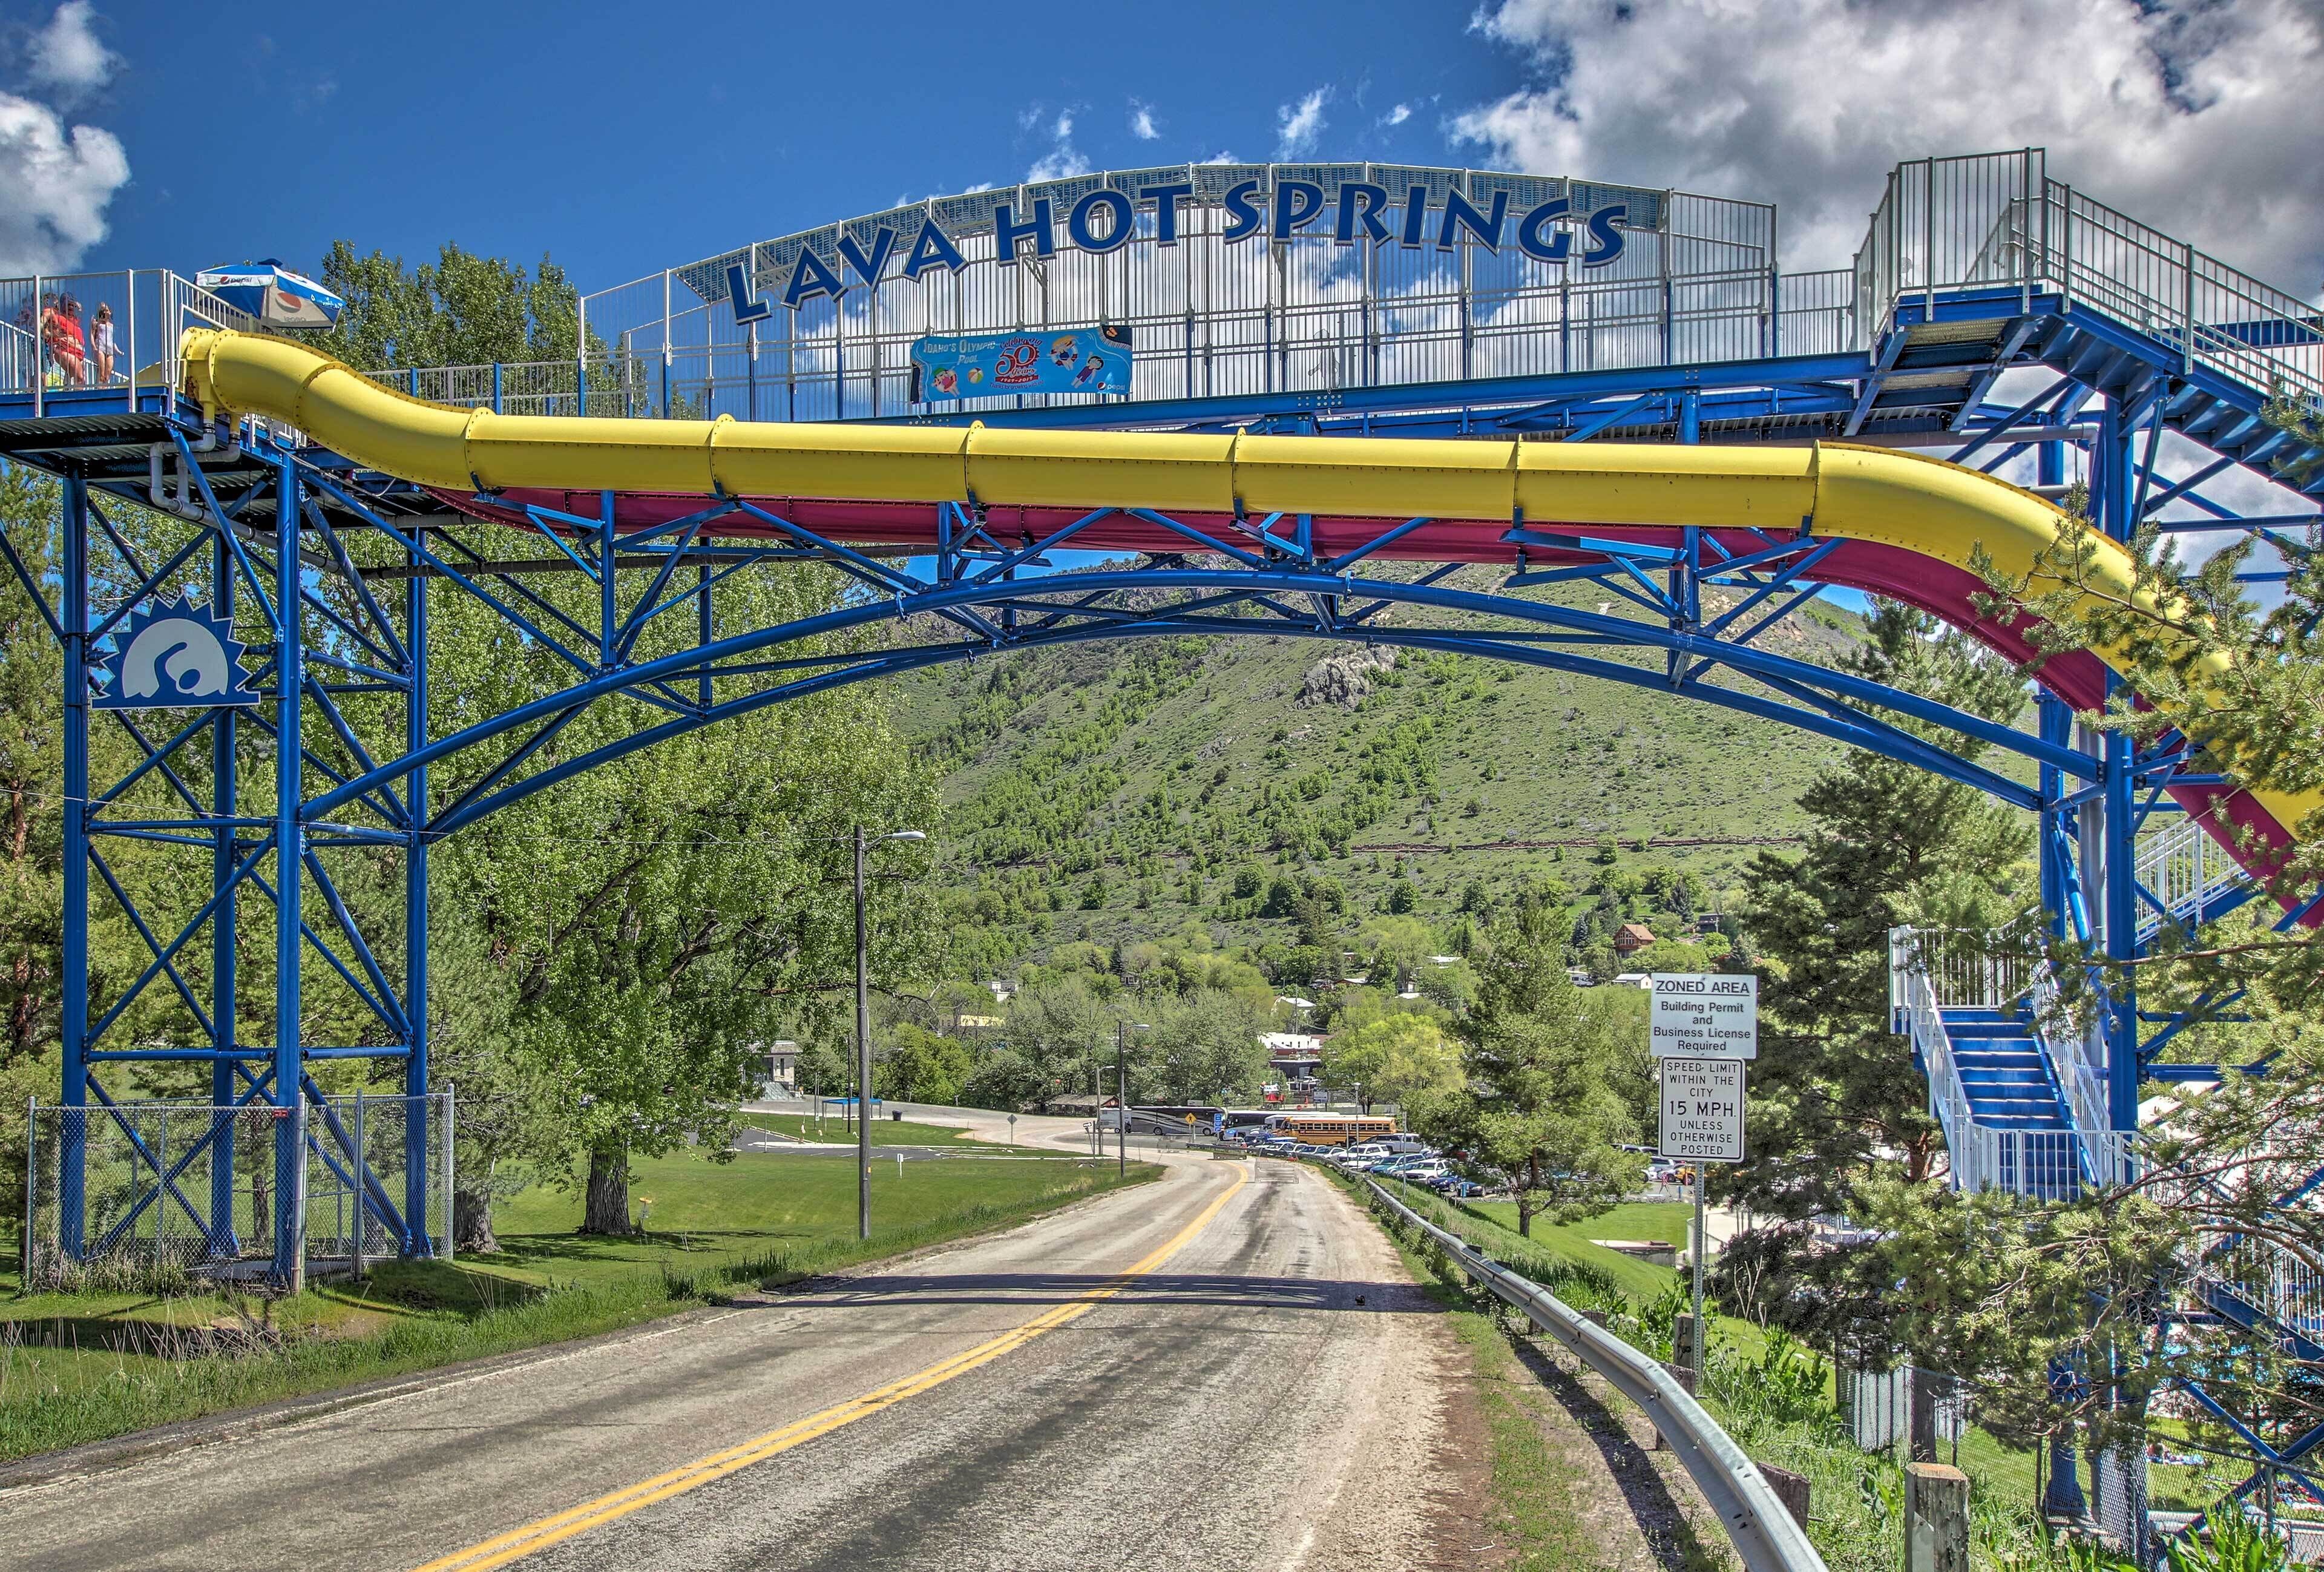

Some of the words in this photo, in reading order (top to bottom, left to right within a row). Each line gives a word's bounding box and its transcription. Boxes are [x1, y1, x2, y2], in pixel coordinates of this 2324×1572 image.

[725, 215, 968, 326] LAVA
[993, 182, 1194, 267] HOT
[1223, 177, 1629, 268] SPRINGS
[1000, 336, 1043, 349] Celebrang
[994, 344, 1037, 376] 50
[1656, 980, 1705, 992] ZONED
[1712, 982, 1750, 993] AREA
[1661, 1001, 1704, 1013] Building
[1709, 1002, 1744, 1012] Permit
[1693, 1016, 1713, 1024] and
[1654, 1027, 1703, 1038] Business
[1709, 1028, 1750, 1038] License
[1678, 1040, 1726, 1051] Required
[1667, 1062, 1702, 1072] SPEED
[1710, 1064, 1738, 1073] LIMIT
[1670, 1074, 1705, 1084] WITHIN
[1714, 1076, 1734, 1085] THE
[1690, 1088, 1713, 1097] CITY
[1670, 1100, 1687, 1115] 15
[1697, 1102, 1736, 1117] M.P.H.
[1680, 1120, 1722, 1130] UNLESS
[1670, 1132, 1732, 1143] OTHERWISE
[1681, 1145, 1723, 1154] POSTED
